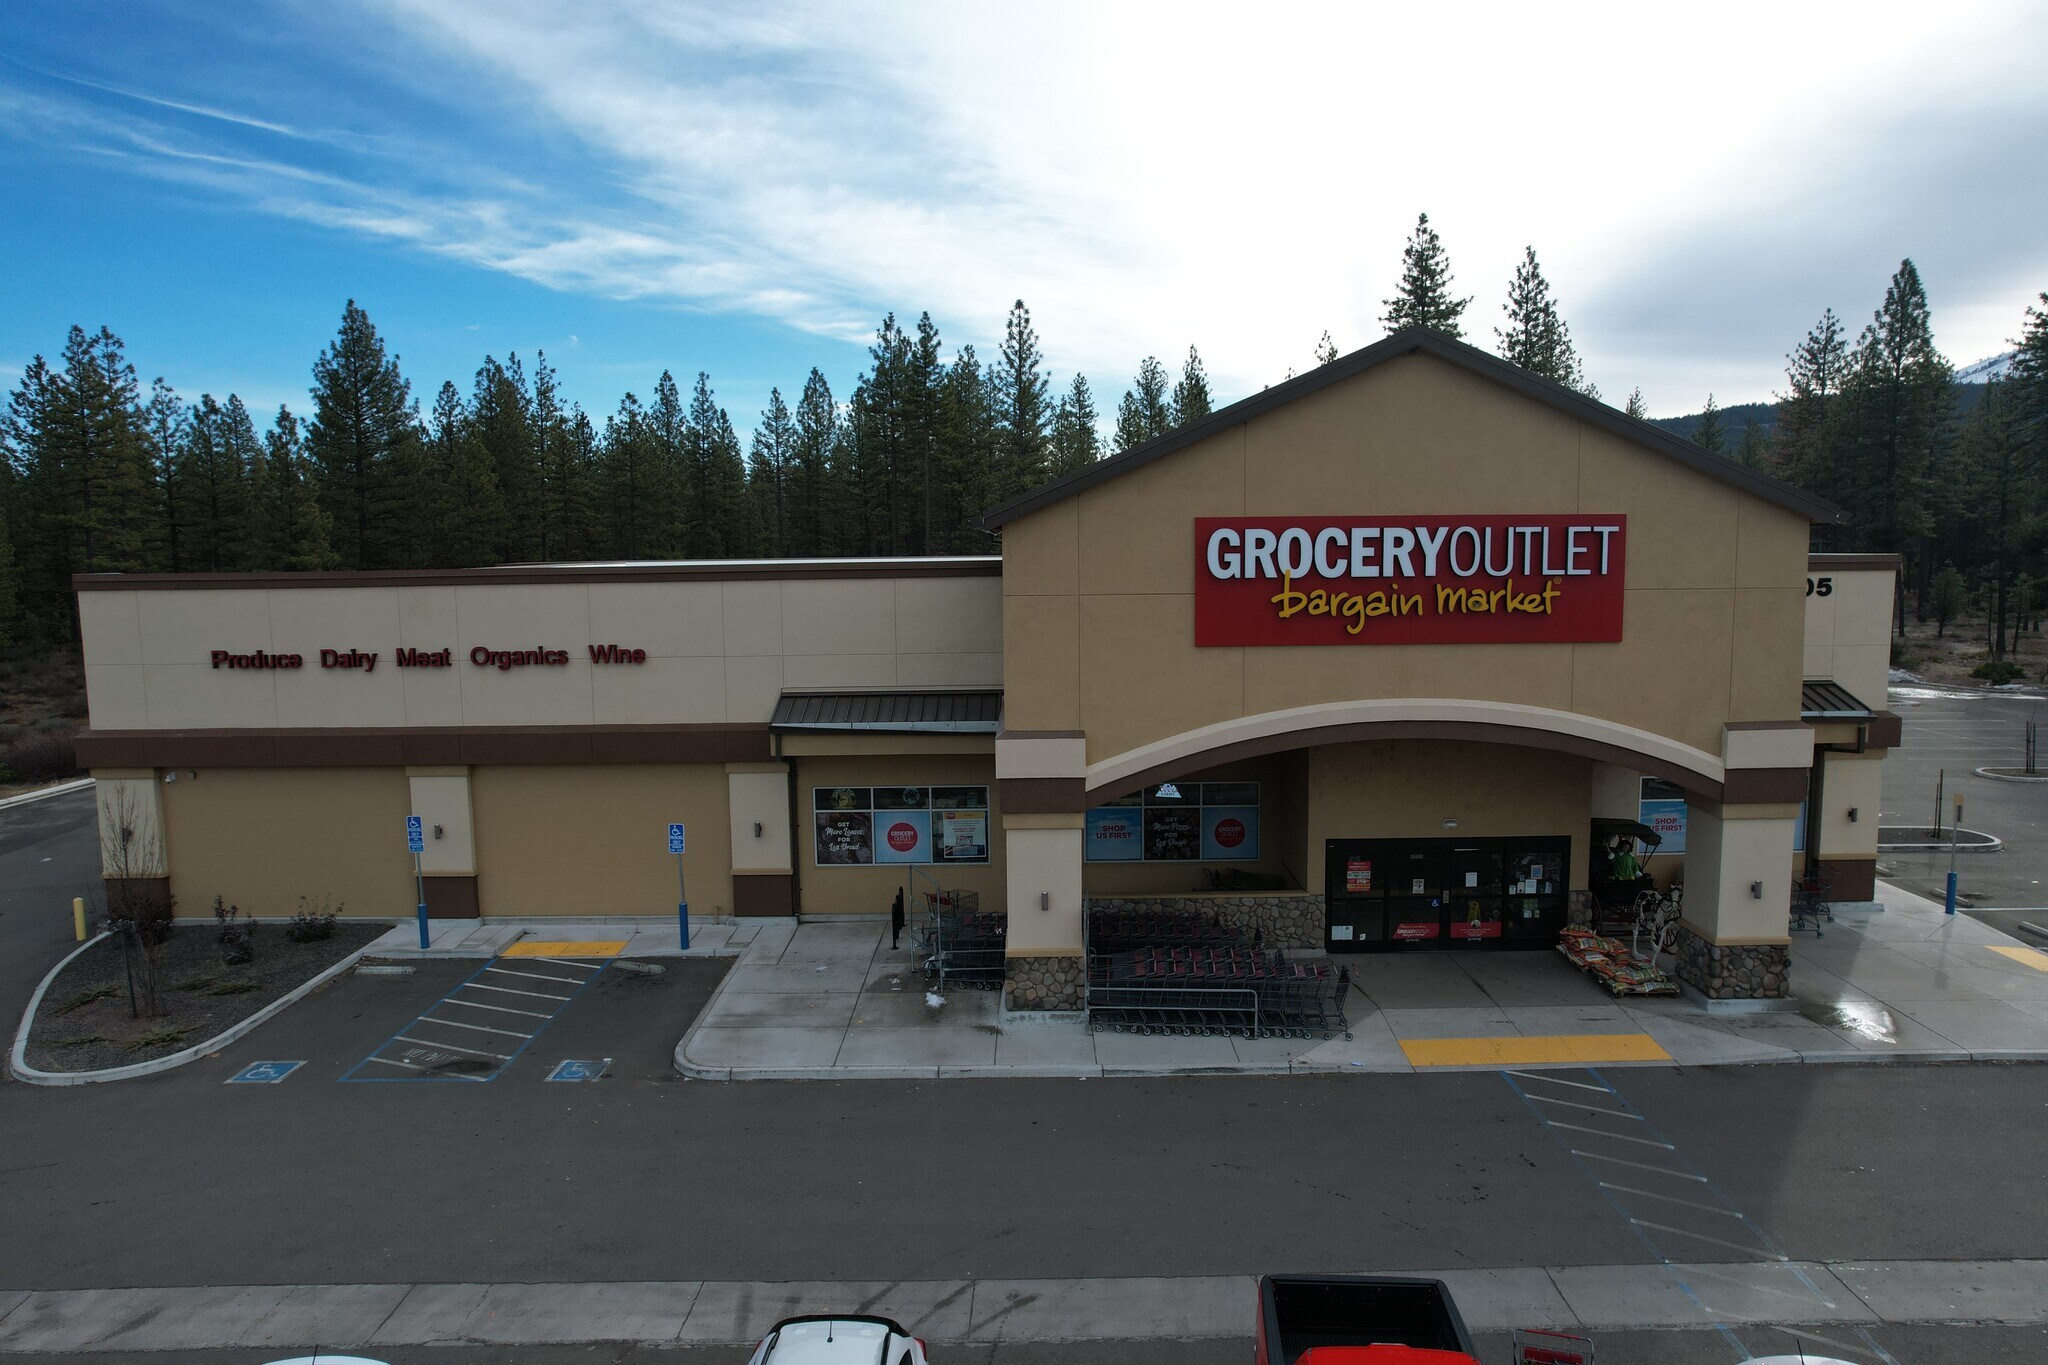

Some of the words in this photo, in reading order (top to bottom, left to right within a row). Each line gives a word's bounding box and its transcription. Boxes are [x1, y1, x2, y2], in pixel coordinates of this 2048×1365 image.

[1270, 568, 1423, 635] bargain
[1436, 578, 1562, 615] market
[211, 649, 303, 669] Produce
[320, 648, 378, 672] Dairy
[396, 647, 452, 667] Meat
[470, 645, 569, 671] Organics
[588, 644, 646, 664] Wine
